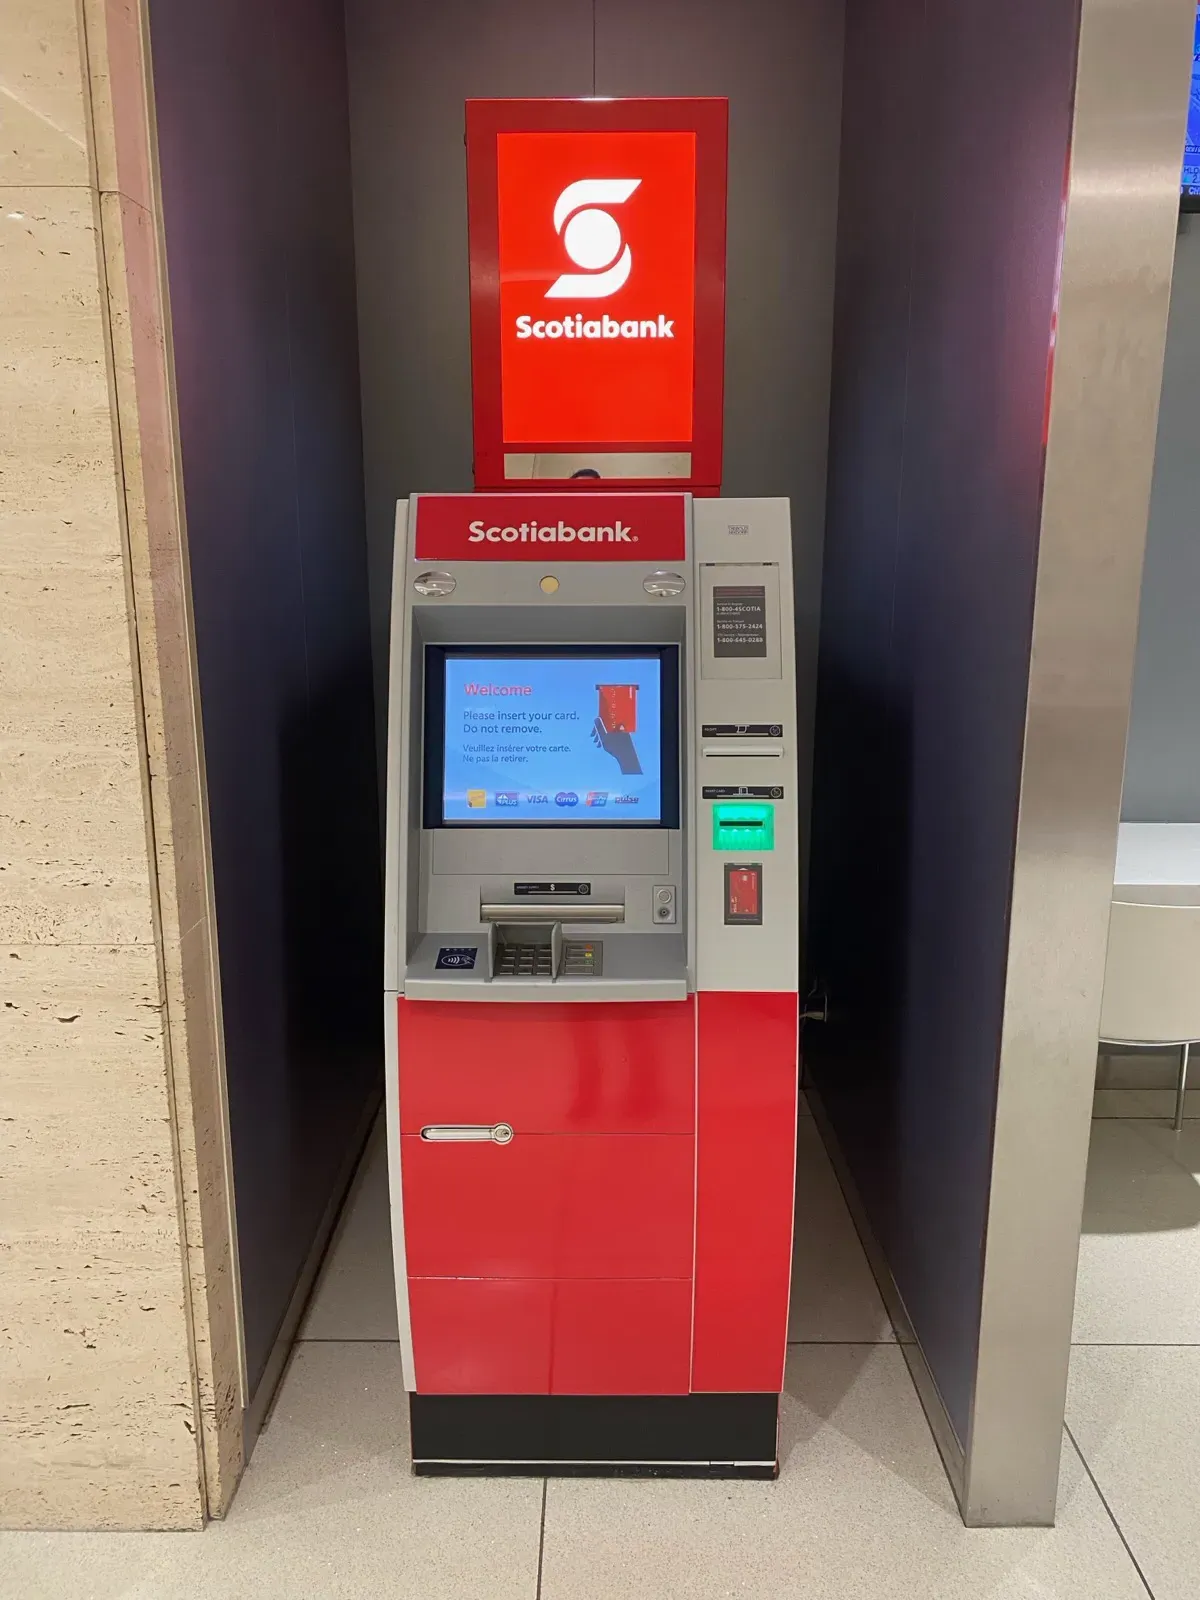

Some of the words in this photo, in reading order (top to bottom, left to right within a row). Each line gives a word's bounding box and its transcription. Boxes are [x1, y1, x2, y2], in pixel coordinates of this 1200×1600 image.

[515, 312, 675, 340] Scotiabank
[467, 520, 633, 543] Scotiabank
[464, 683, 533, 697] Welcome
[463, 711, 495, 721] Please
[497, 711, 526, 721] insert
[528, 712, 553, 724] your
[554, 711, 580, 721] card.
[463, 724, 478, 734] Do
[480, 724, 499, 734] not
[501, 725, 543, 734] remove.
[463, 744, 495, 753] Veuillez
[496, 744, 523, 753] insérer
[525, 744, 547, 753] votre
[548, 744, 571, 753] carte.
[462, 754, 474, 763] Ne
[475, 755, 490, 765] pas
[491, 754, 499, 763] la
[500, 754, 529, 763] retirer.
[527, 795, 548, 804] VISA
